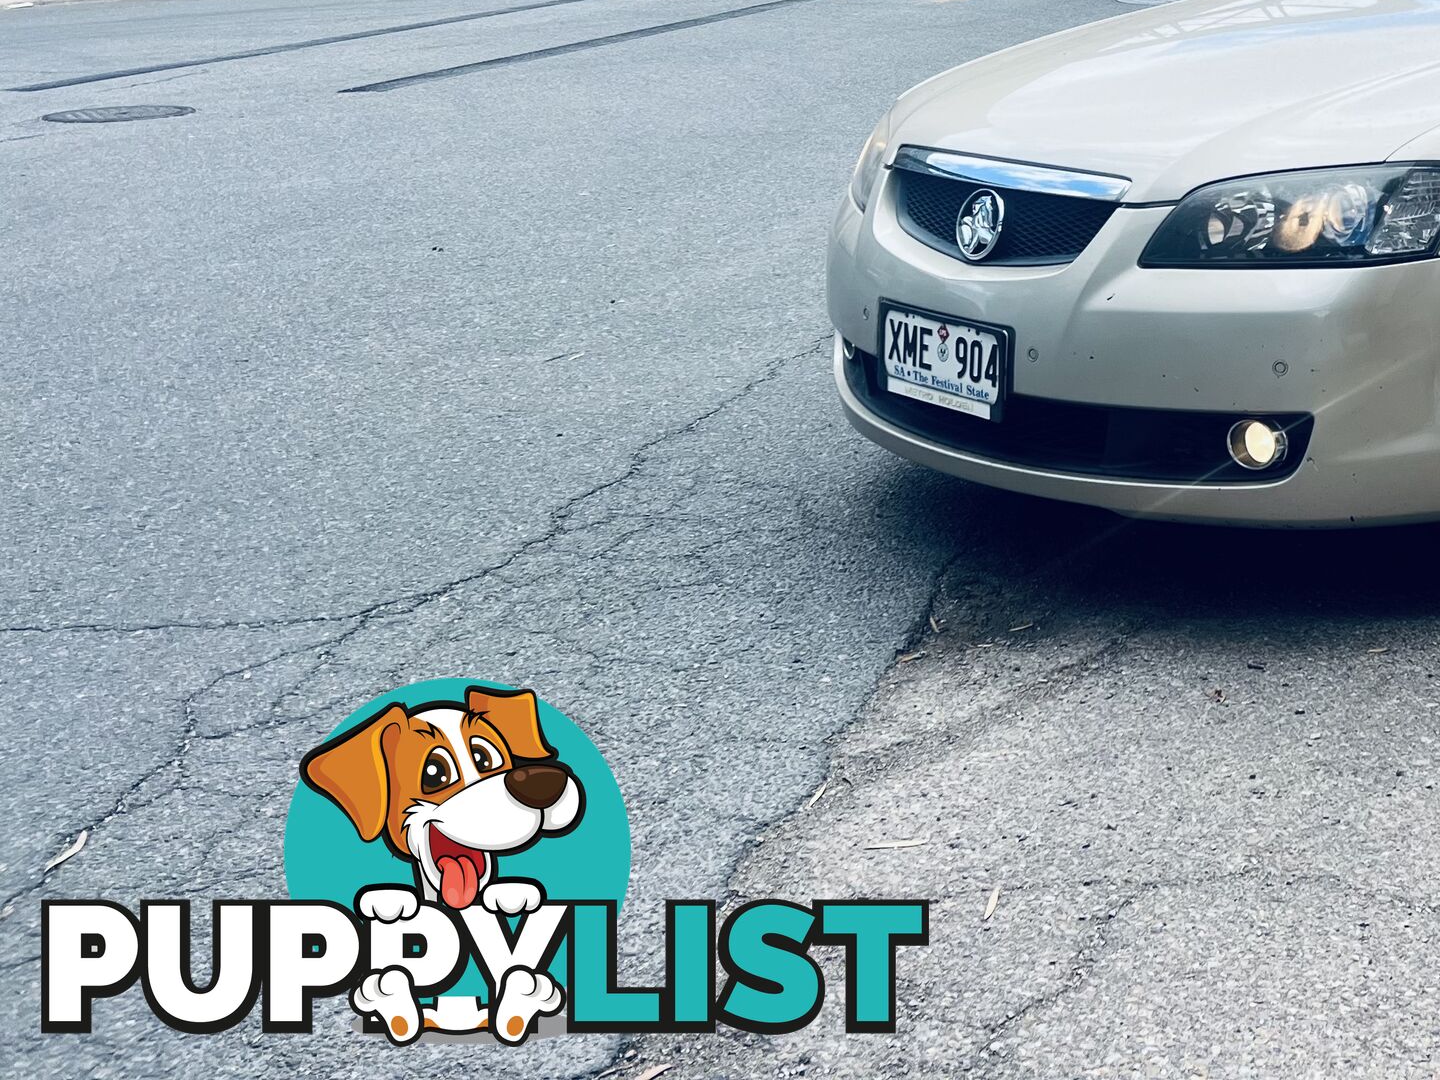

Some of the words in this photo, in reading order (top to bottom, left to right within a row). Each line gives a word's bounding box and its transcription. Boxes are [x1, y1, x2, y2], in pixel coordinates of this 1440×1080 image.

[888, 318, 933, 371] XME
[955, 336, 998, 388] 904
[894, 365, 906, 377] SA
[913, 370, 929, 384] The
[931, 375, 964, 394] Festival
[966, 384, 990, 400] State
